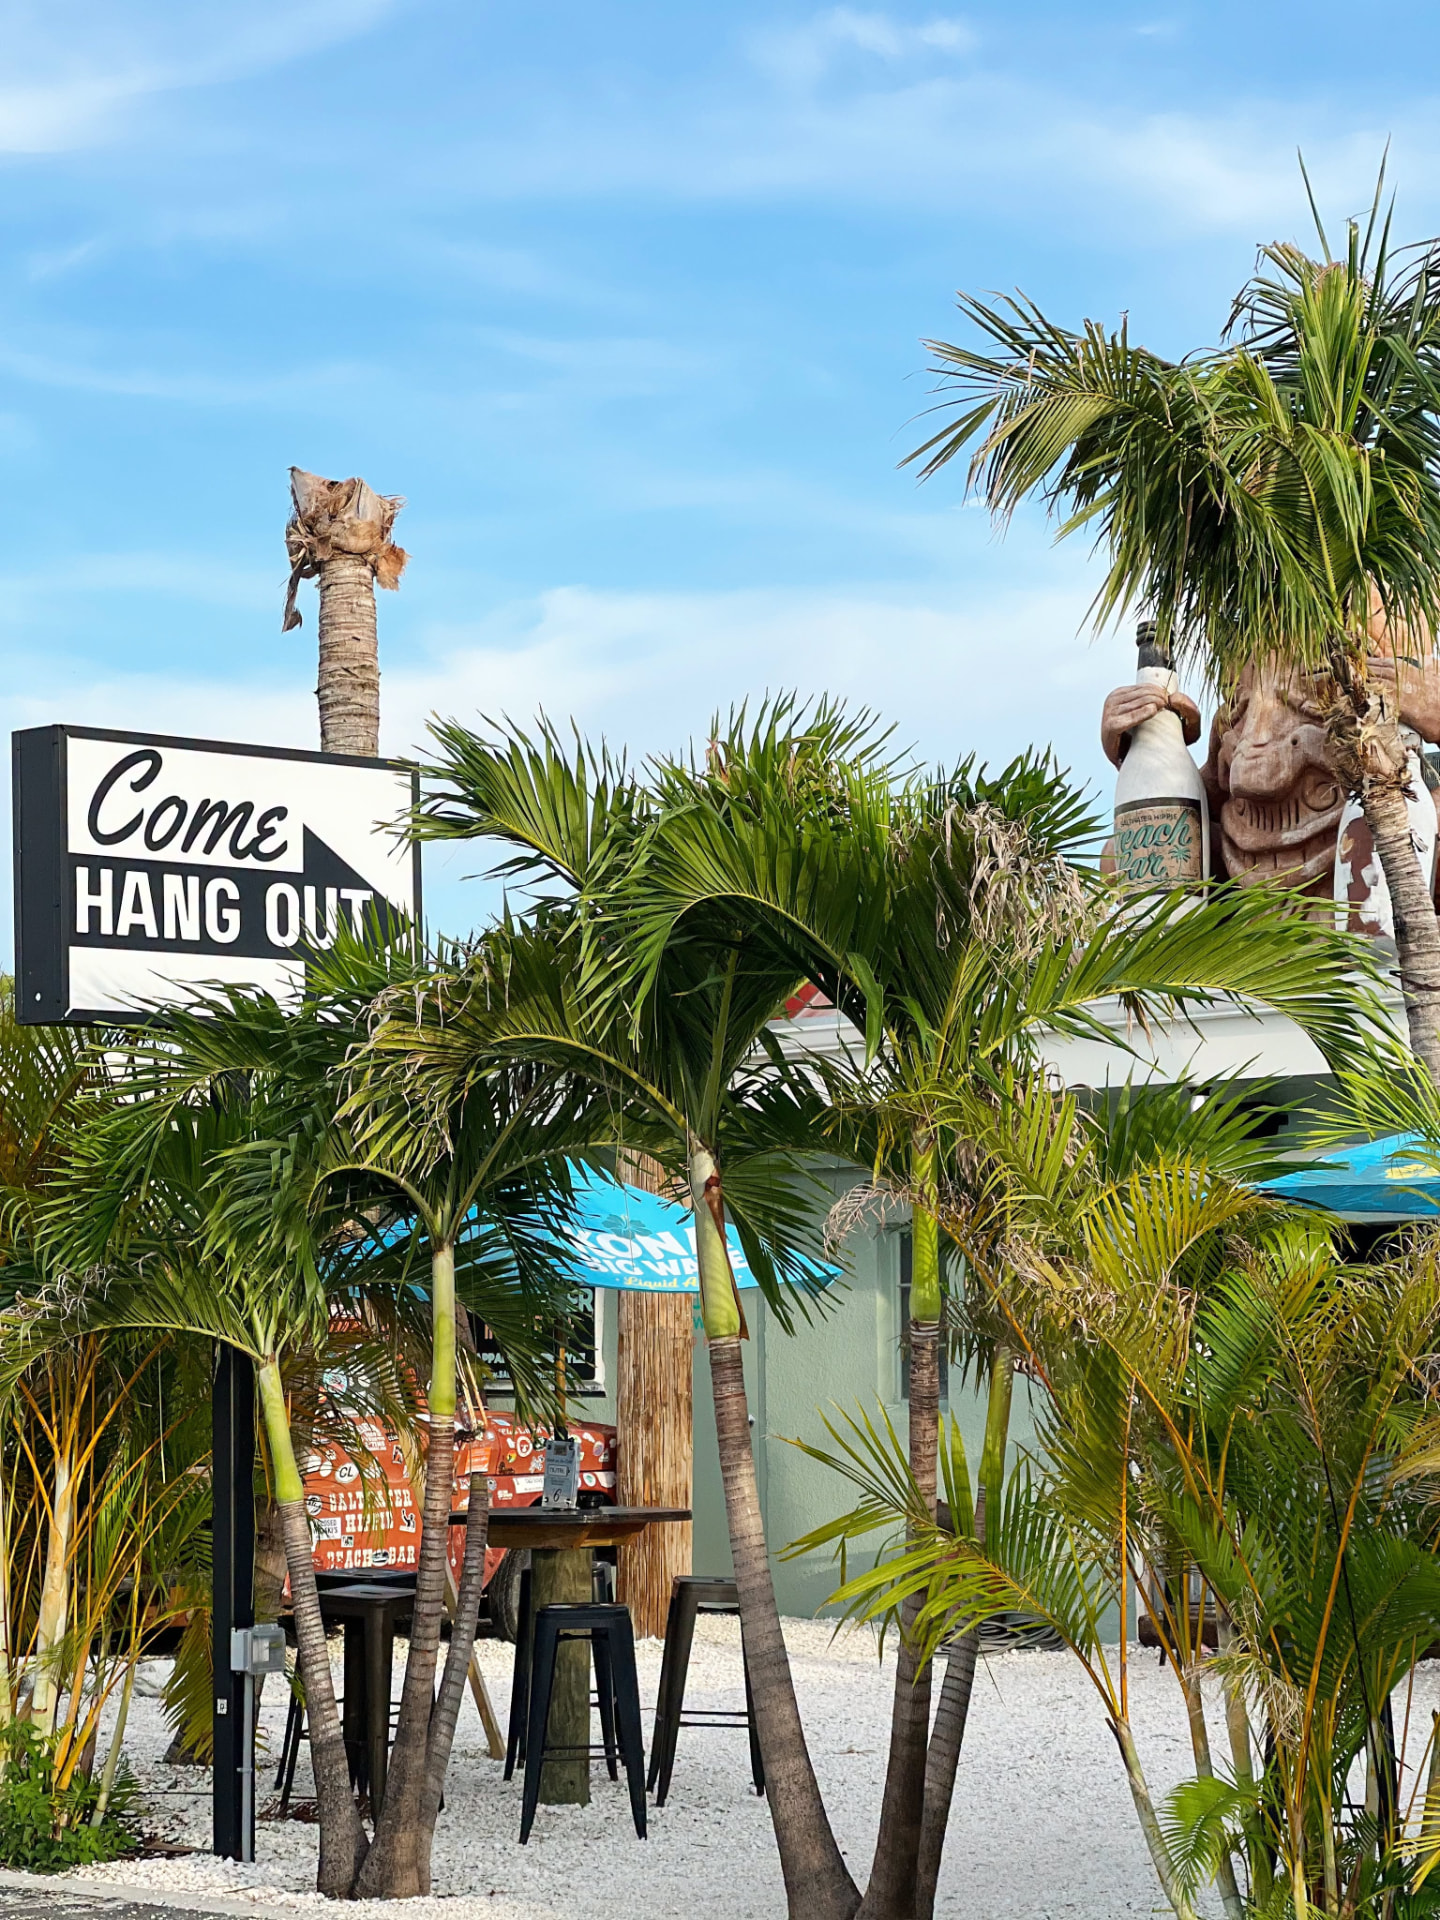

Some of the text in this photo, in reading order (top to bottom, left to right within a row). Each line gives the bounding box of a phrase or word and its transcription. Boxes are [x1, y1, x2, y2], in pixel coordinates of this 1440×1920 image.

[88, 749, 288, 862] Come
[1115, 808, 1192, 853] each
[75, 866, 374, 951] HANG OUT
[585, 1250, 747, 1277] BIG WAE
[623, 1275, 679, 1288] Liquid
[339, 1466, 354, 1478] CL
[387, 1545, 416, 1565] BAR
